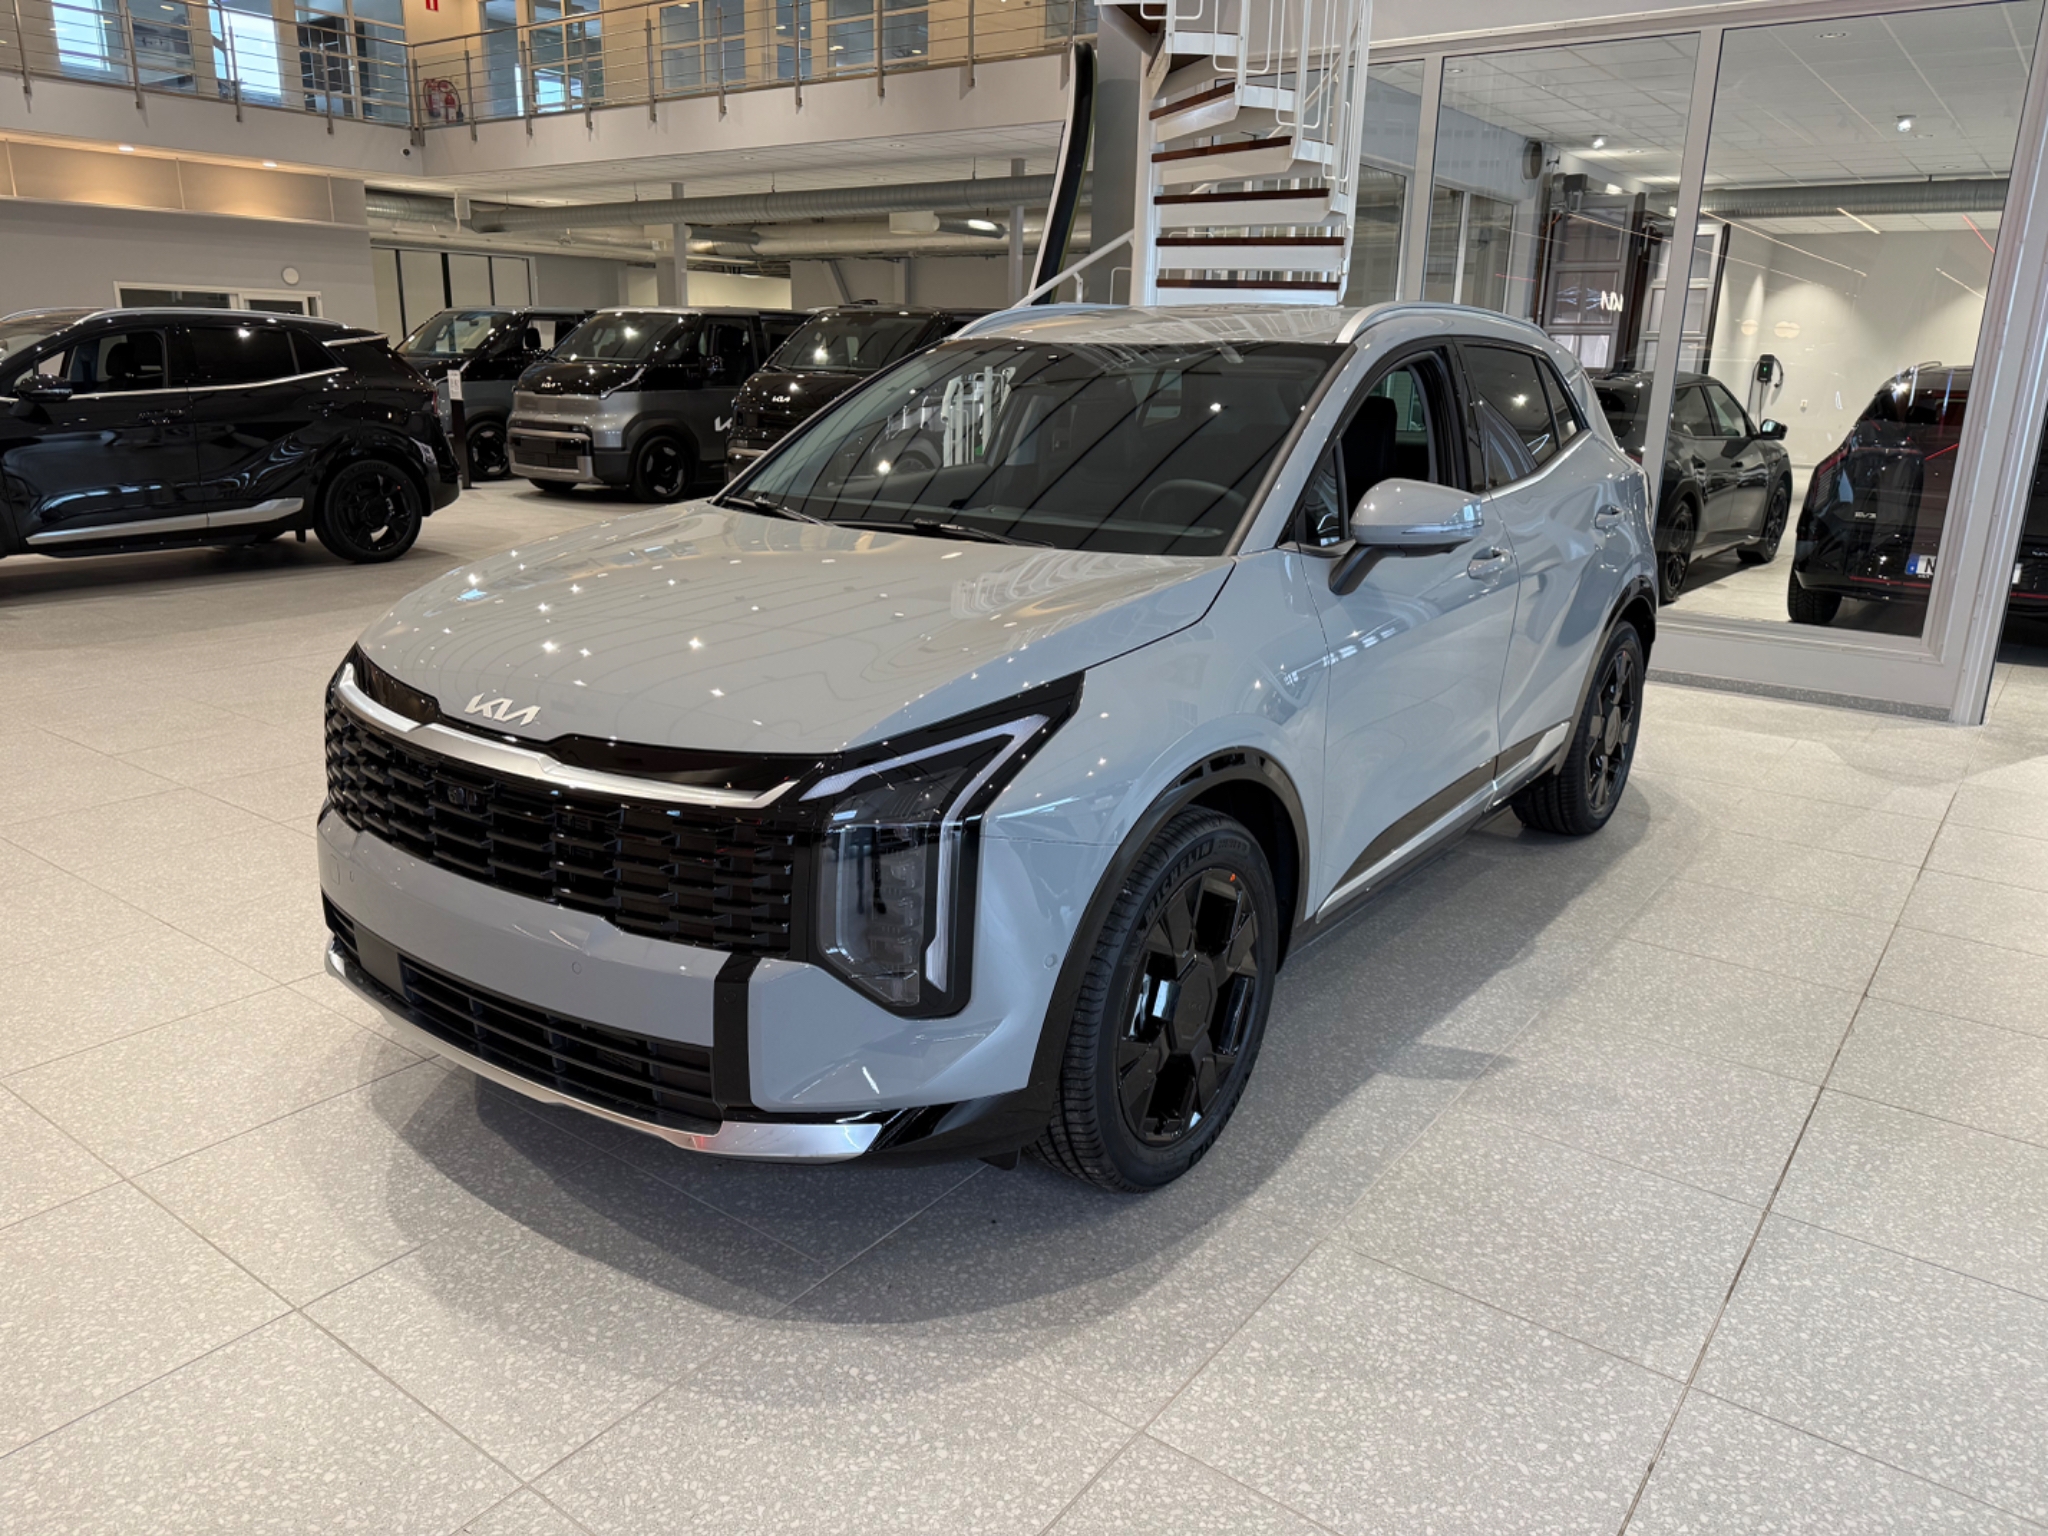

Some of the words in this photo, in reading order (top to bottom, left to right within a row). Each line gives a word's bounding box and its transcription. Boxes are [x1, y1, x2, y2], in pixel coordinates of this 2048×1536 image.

[772, 395, 791, 403] KIA
[464, 692, 541, 726] KIA
[1143, 839, 1212, 924] MICHELIN
